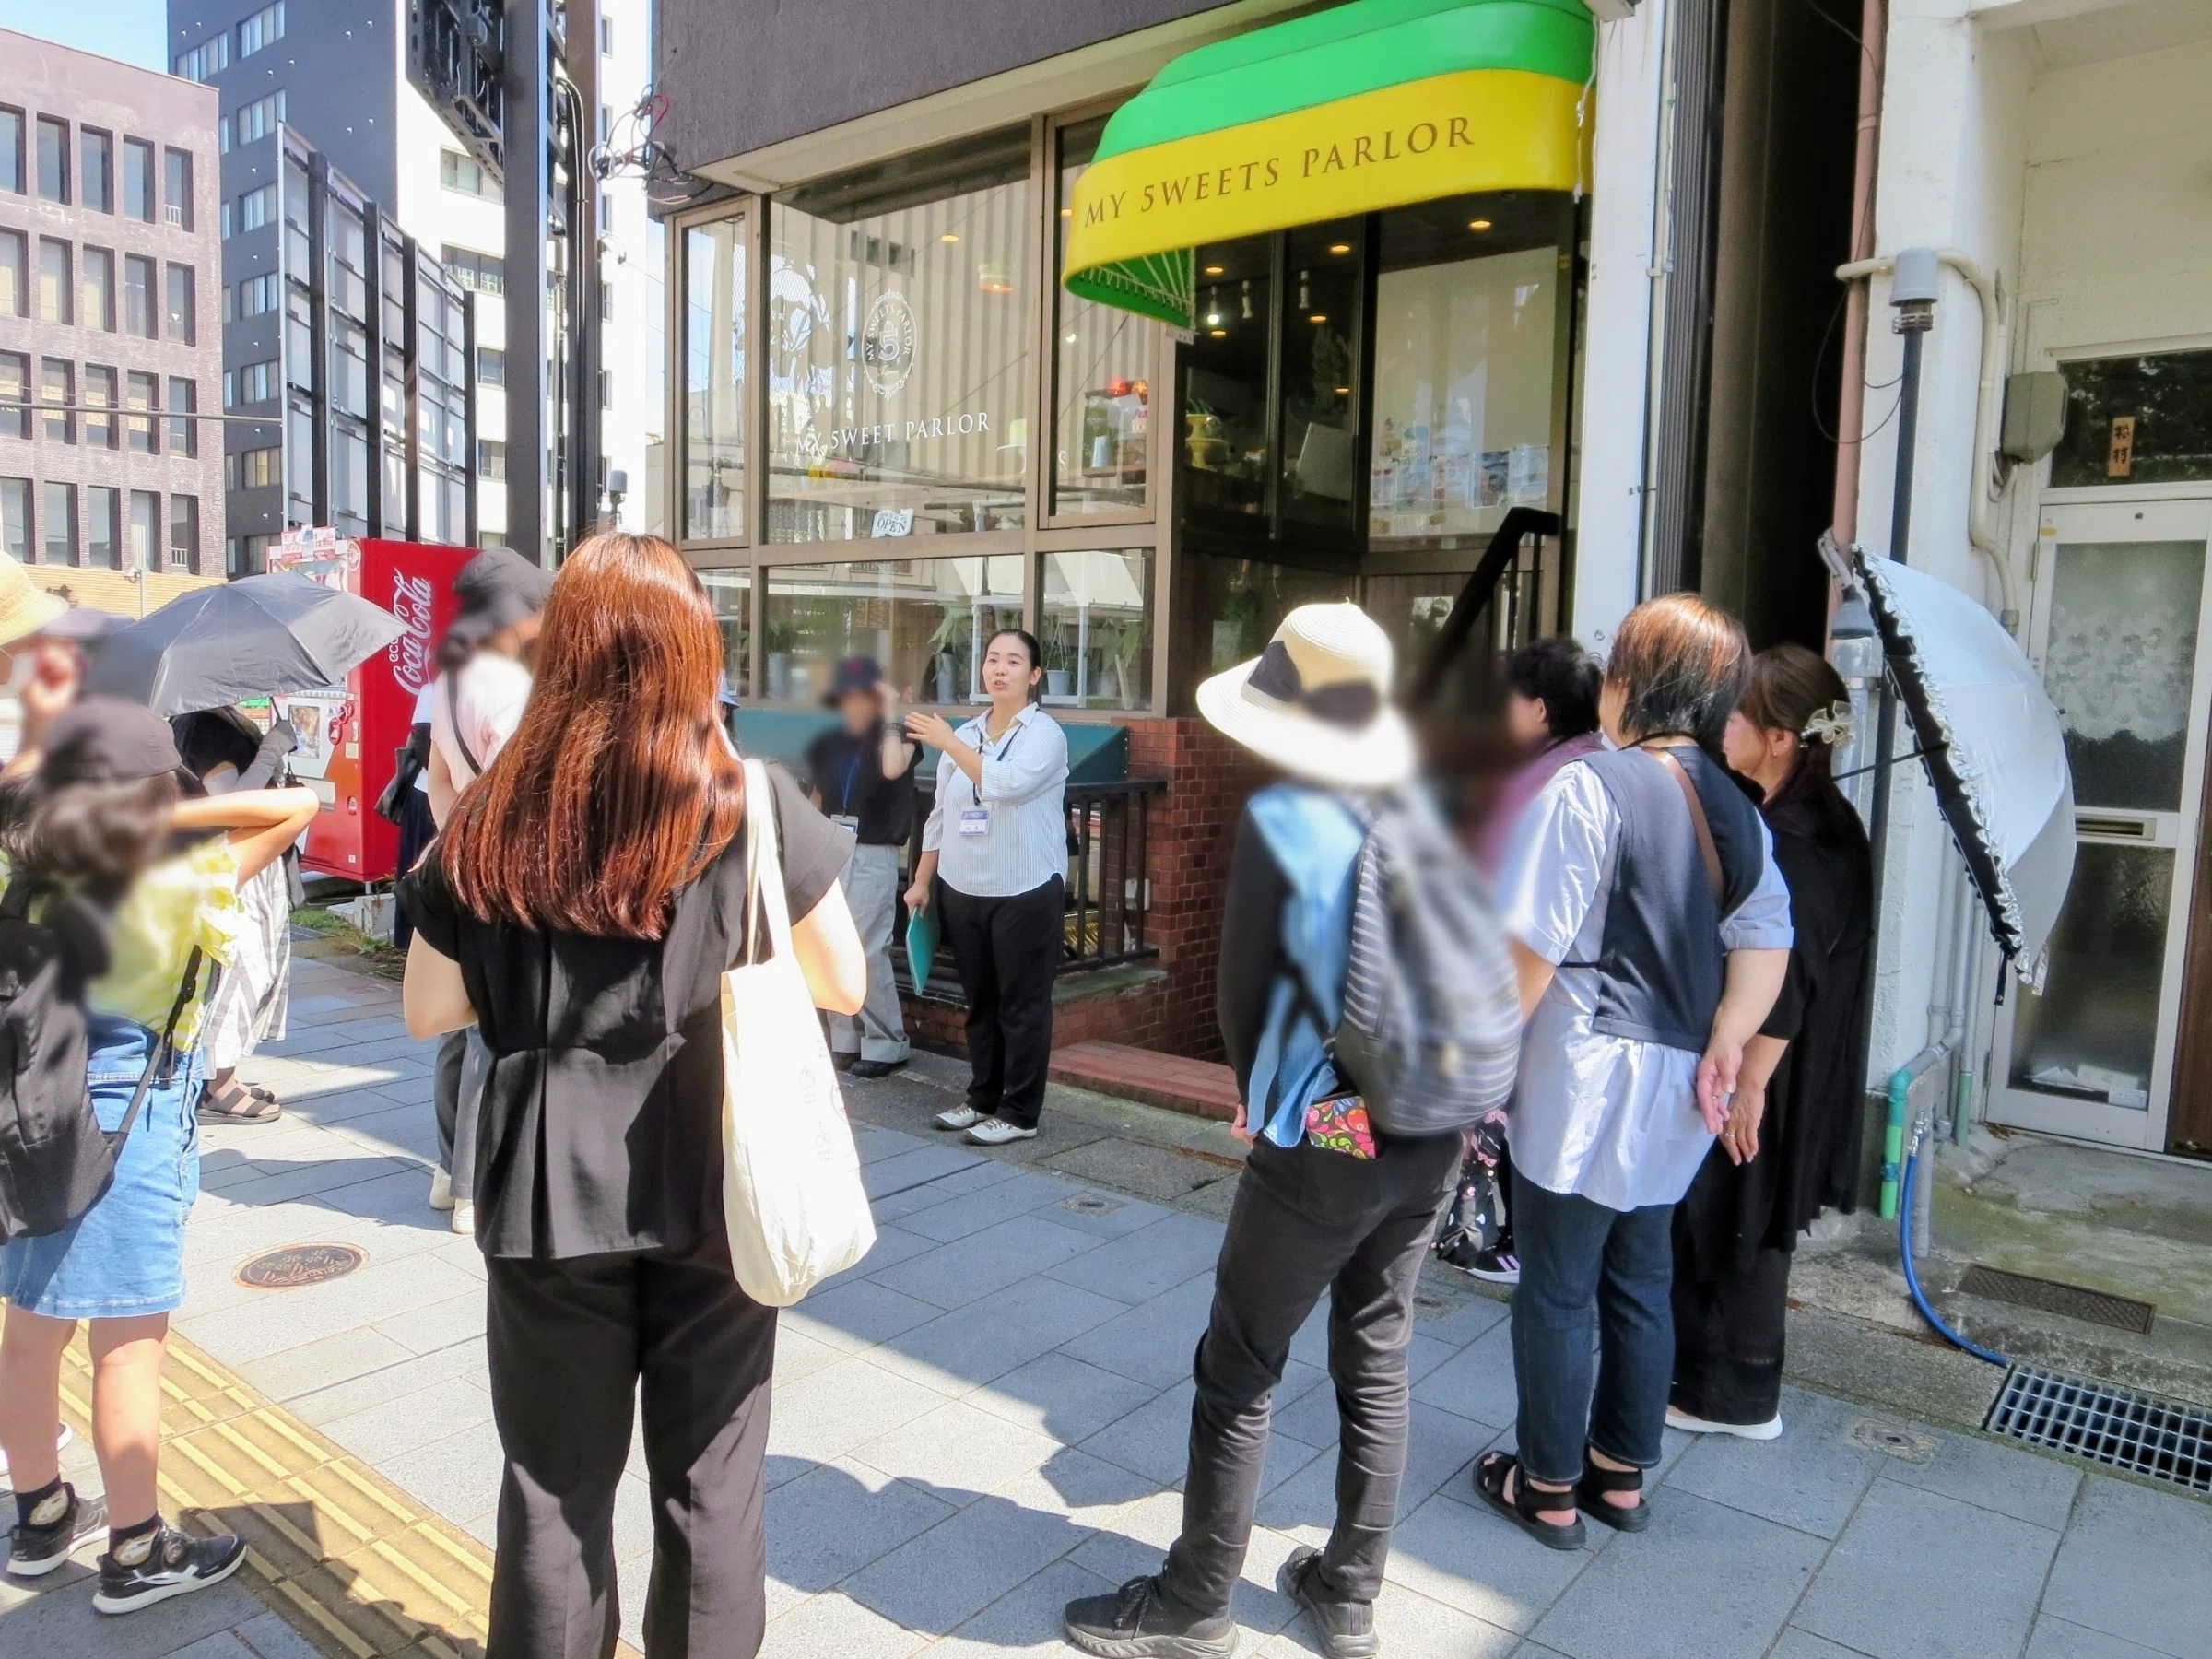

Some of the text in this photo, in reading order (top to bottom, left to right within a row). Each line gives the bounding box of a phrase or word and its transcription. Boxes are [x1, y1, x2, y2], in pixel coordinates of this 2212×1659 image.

[1085, 191, 1127, 228] MY
[1301, 117, 1476, 178] PARLOR
[866, 340, 875, 361] MY
[897, 308, 912, 355] PARLOR
[794, 432, 822, 453] MY
[906, 412, 992, 440] PARLOR
[877, 517, 907, 533] OPEN
